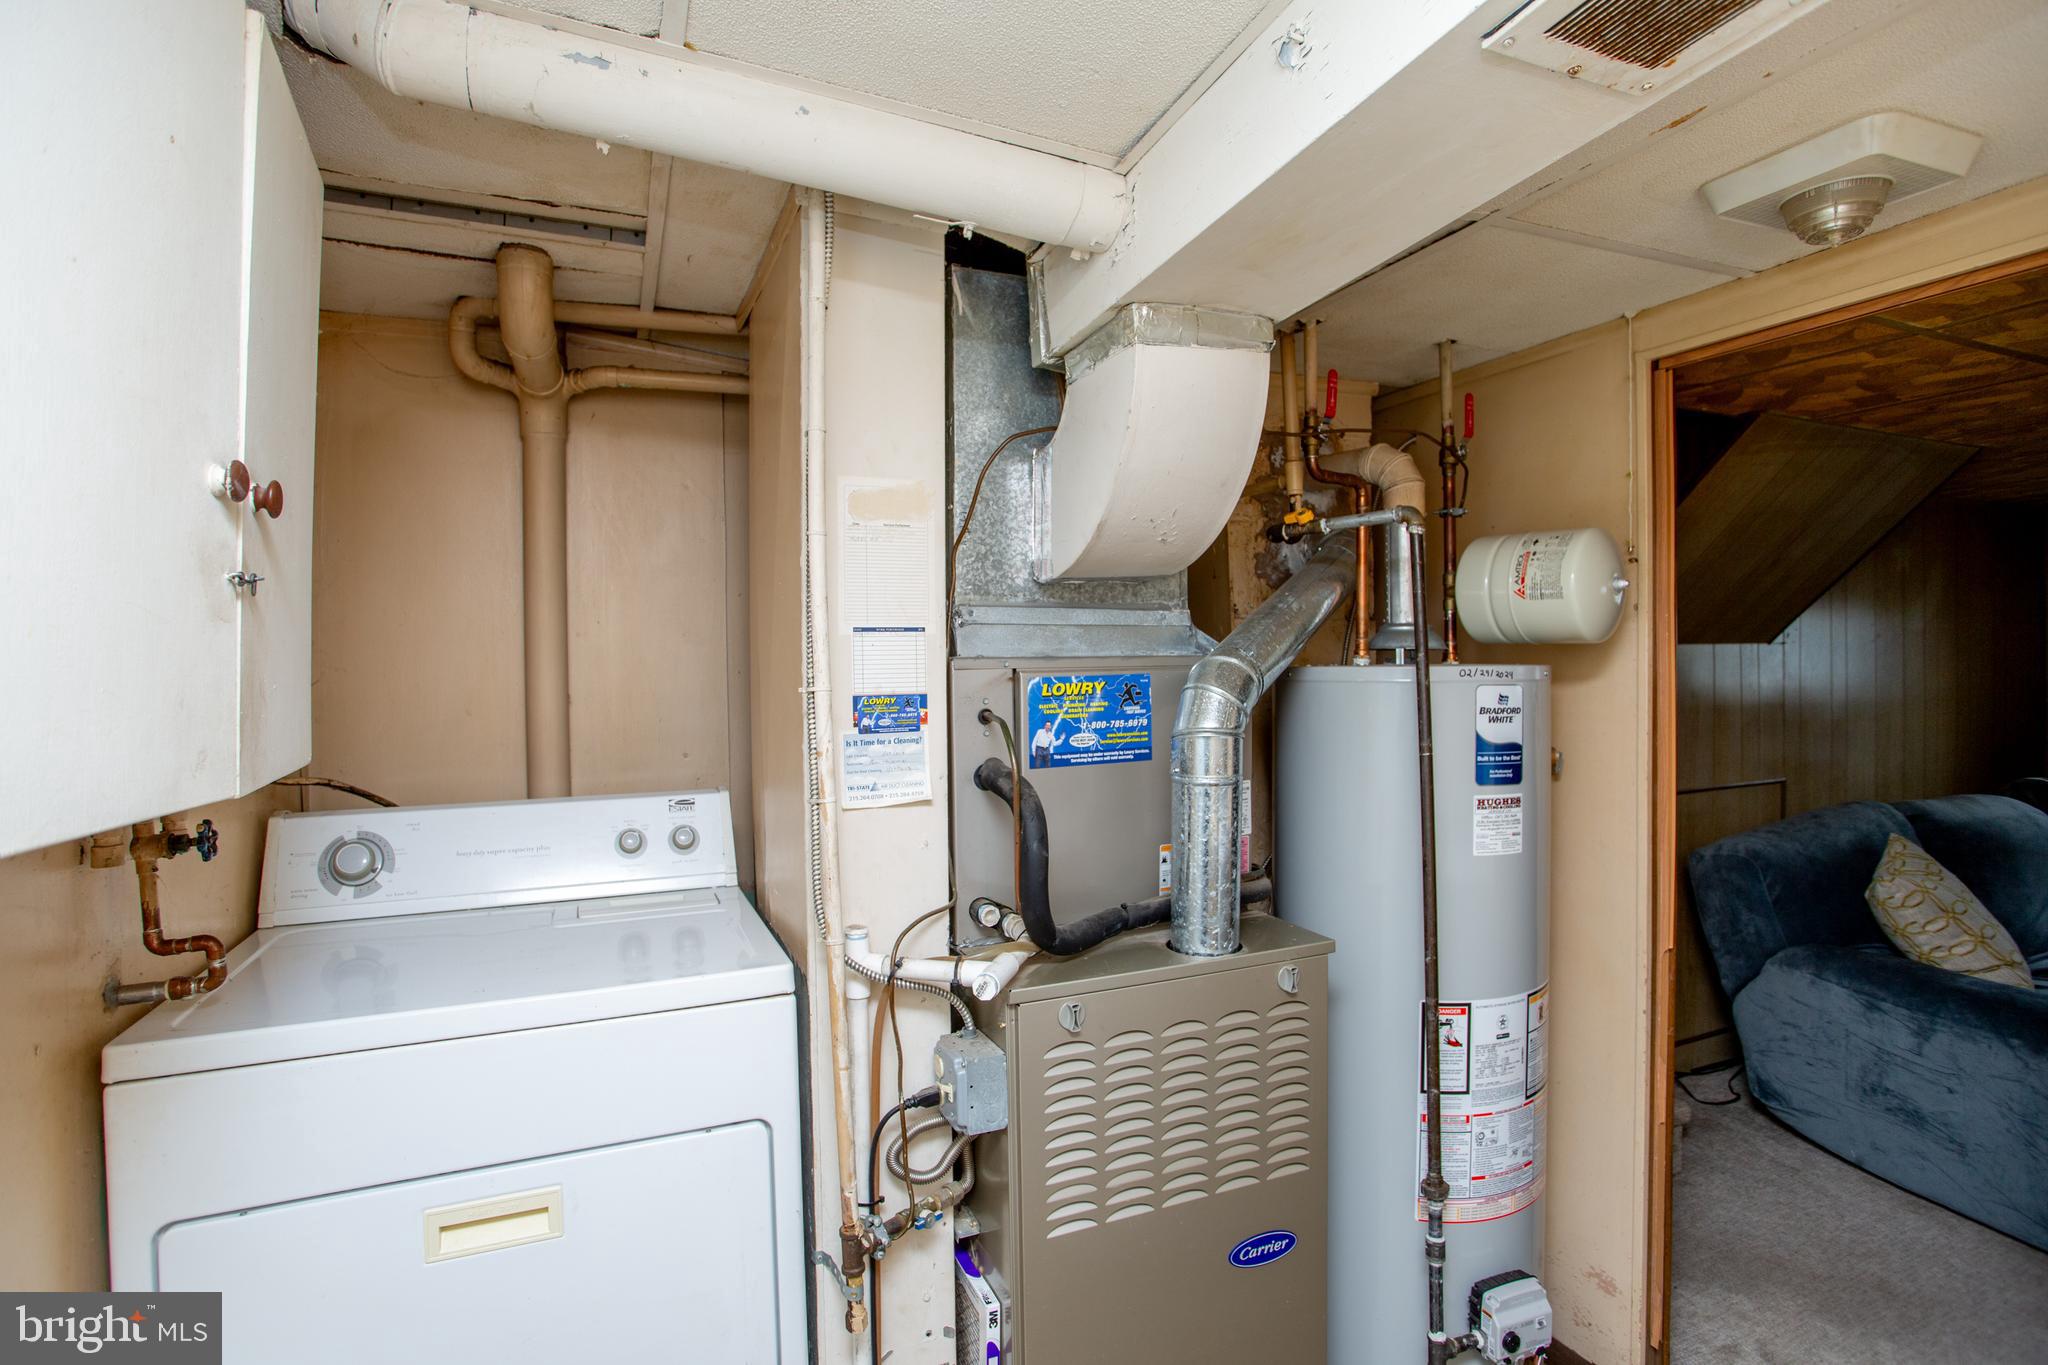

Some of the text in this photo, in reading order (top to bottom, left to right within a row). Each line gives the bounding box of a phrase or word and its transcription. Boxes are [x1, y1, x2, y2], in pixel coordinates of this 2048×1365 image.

[1042, 682, 1106, 697] LOWRY
[864, 697, 896, 706] LOWRY
[1477, 796, 1520, 806] HUGHES
[1240, 1239, 1289, 1260] Carrier
[989, 1310, 998, 1329] 3M
